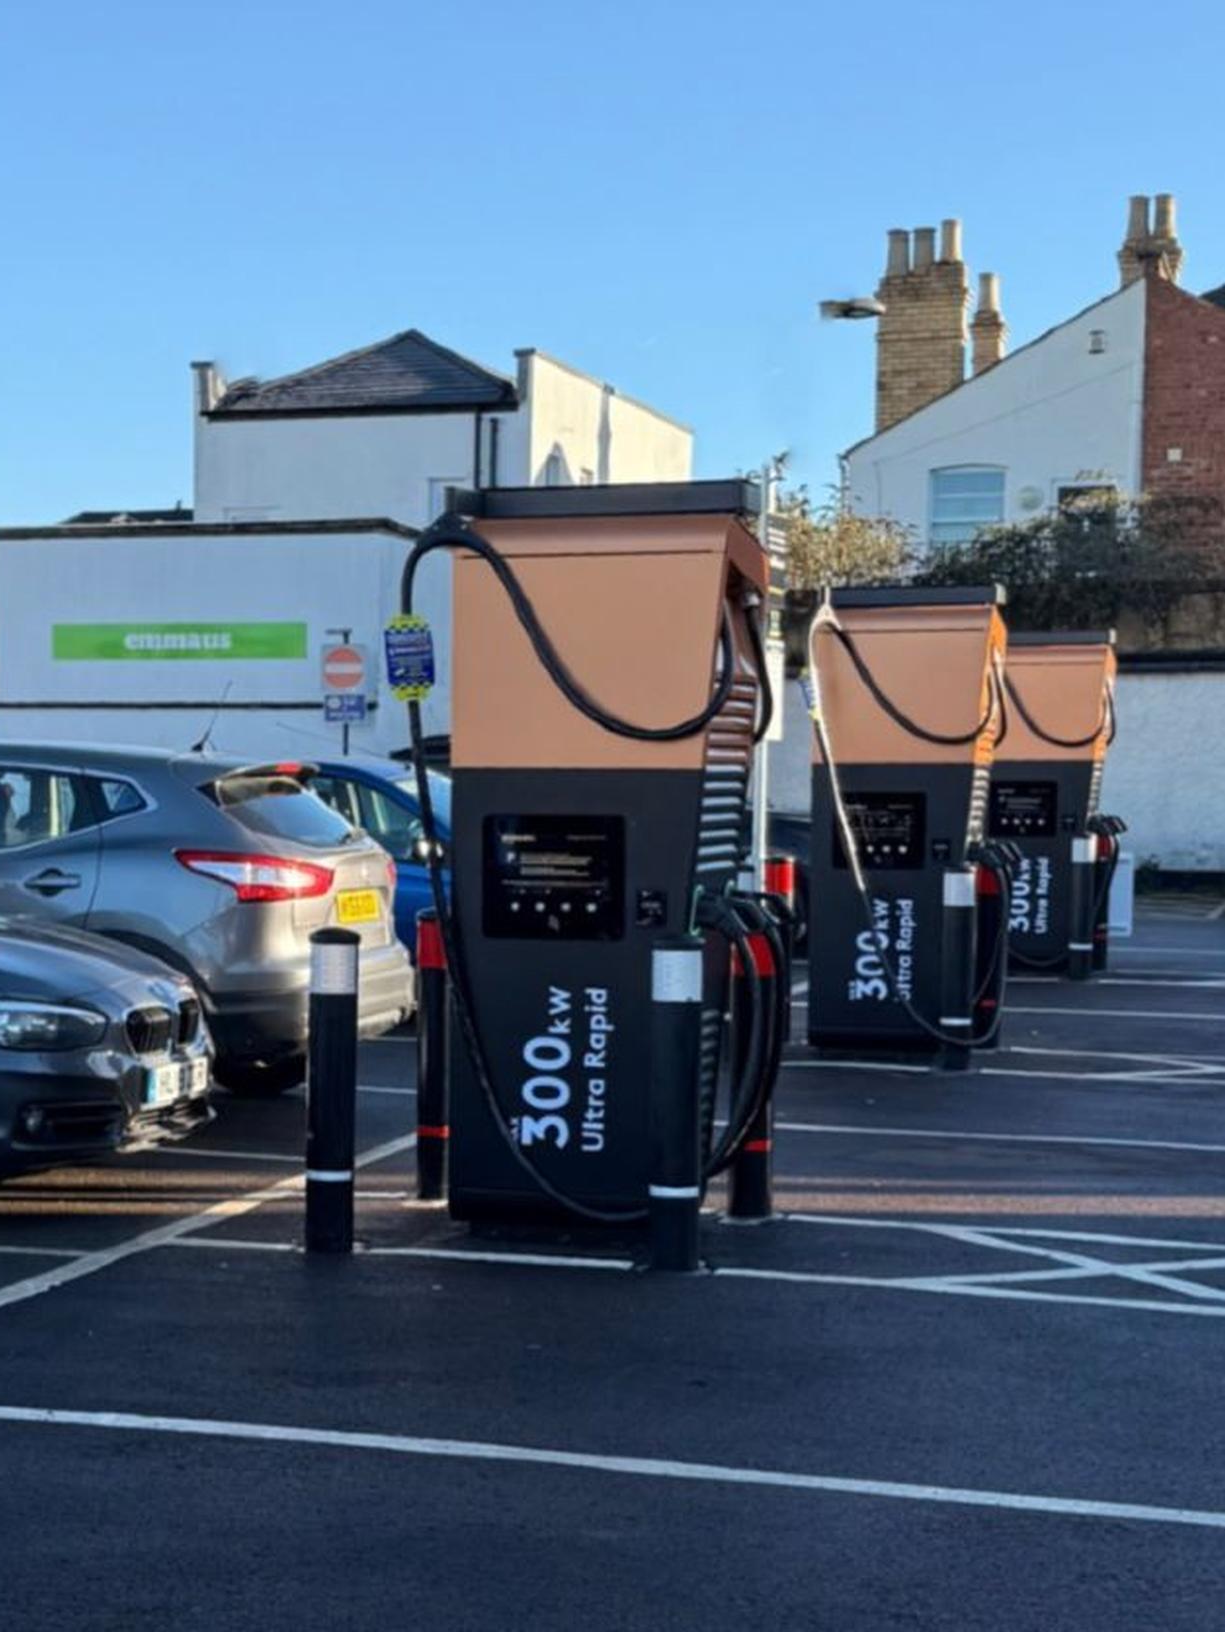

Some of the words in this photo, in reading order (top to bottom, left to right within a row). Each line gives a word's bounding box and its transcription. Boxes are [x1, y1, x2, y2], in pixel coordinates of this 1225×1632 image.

[124, 631, 232, 651] emmaus
[1036, 856, 1052, 895] Rapid
[895, 899, 918, 951] Rapid
[1034, 897, 1049, 933] Ultra
[583, 987, 615, 1068] Rapid
[520, 985, 572, 1149] 300kW
[580, 1078, 606, 1152] Ultra
